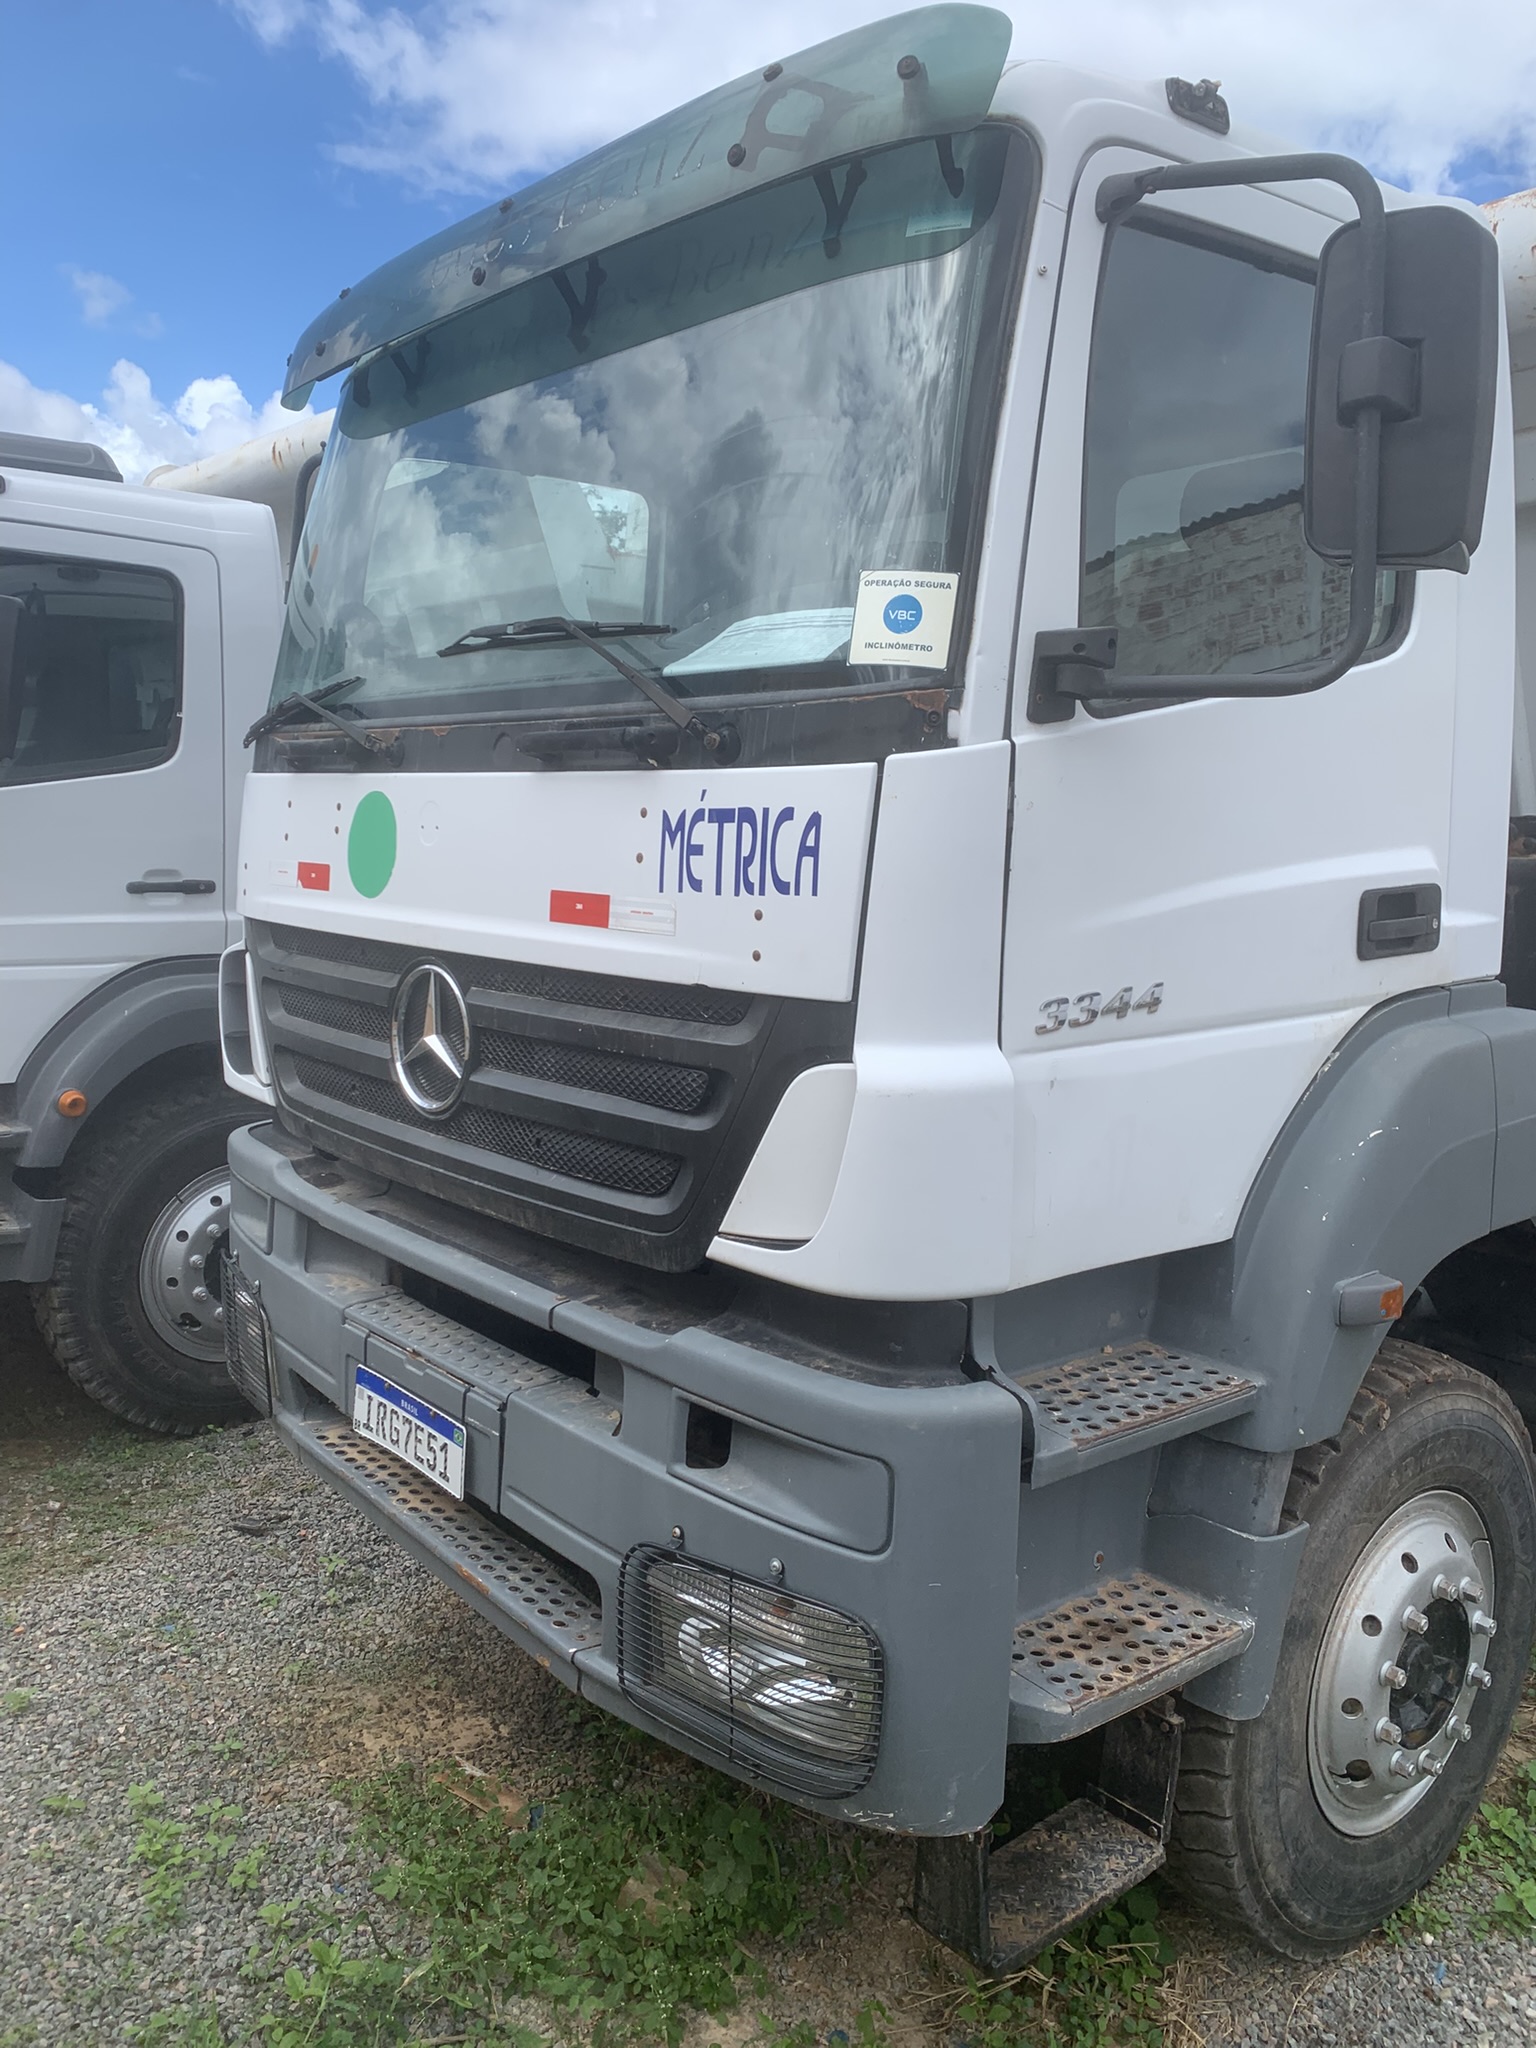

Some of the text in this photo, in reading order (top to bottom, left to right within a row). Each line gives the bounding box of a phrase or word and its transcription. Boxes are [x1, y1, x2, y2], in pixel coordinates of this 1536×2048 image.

[864, 578, 952, 590] OPERAÇÃO SEGURA
[888, 609, 917, 621] VBC
[864, 641, 934, 653] INCLINÔMETRO
[658, 788, 822, 897] MÉTRICA
[1035, 982, 1164, 1036] 3344
[400, 1398, 419, 1416] BRASIL
[362, 1393, 450, 1483] IRG7E51
